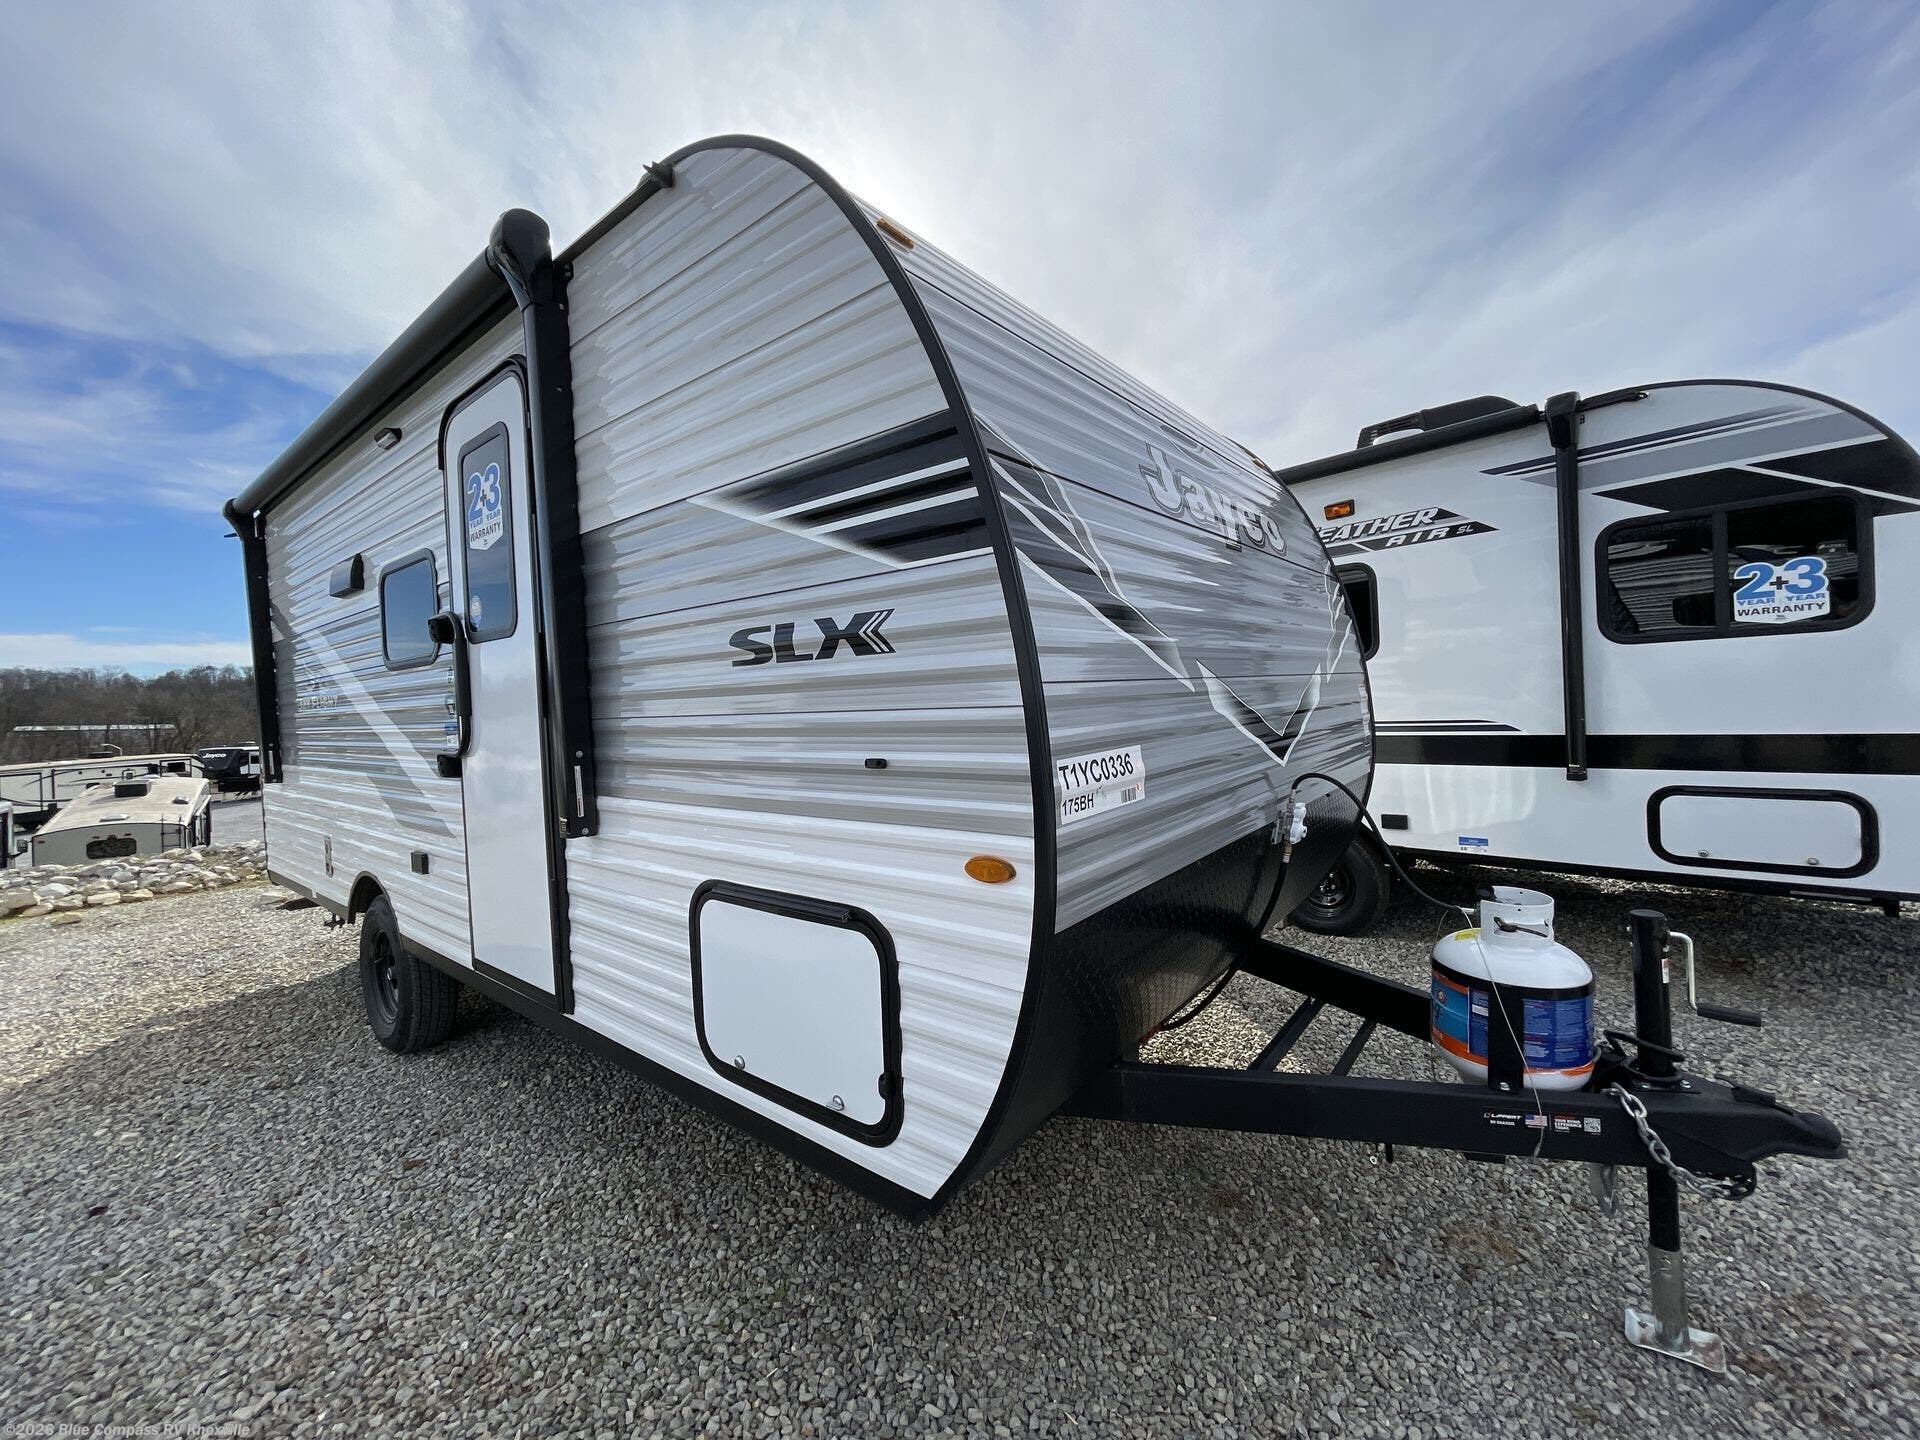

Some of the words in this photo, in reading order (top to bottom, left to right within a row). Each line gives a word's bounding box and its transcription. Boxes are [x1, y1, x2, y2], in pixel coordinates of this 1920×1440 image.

[1138, 442, 1287, 557] Jayco
[470, 518, 483, 529] YEAR
[485, 509, 501, 521] YEAR
[1317, 507, 1439, 543] EATHER
[471, 521, 501, 542] WARRANTY
[1385, 527, 1449, 547] AIR
[1456, 525, 1474, 534] SL
[1737, 598, 1775, 606] YEAR
[1786, 592, 1826, 602] YEAR
[1737, 602, 1826, 617] WARRANTY
[729, 608, 896, 667] SLX
[1058, 753, 1134, 790] T1YC0336
[1062, 792, 1095, 816] 175BH
